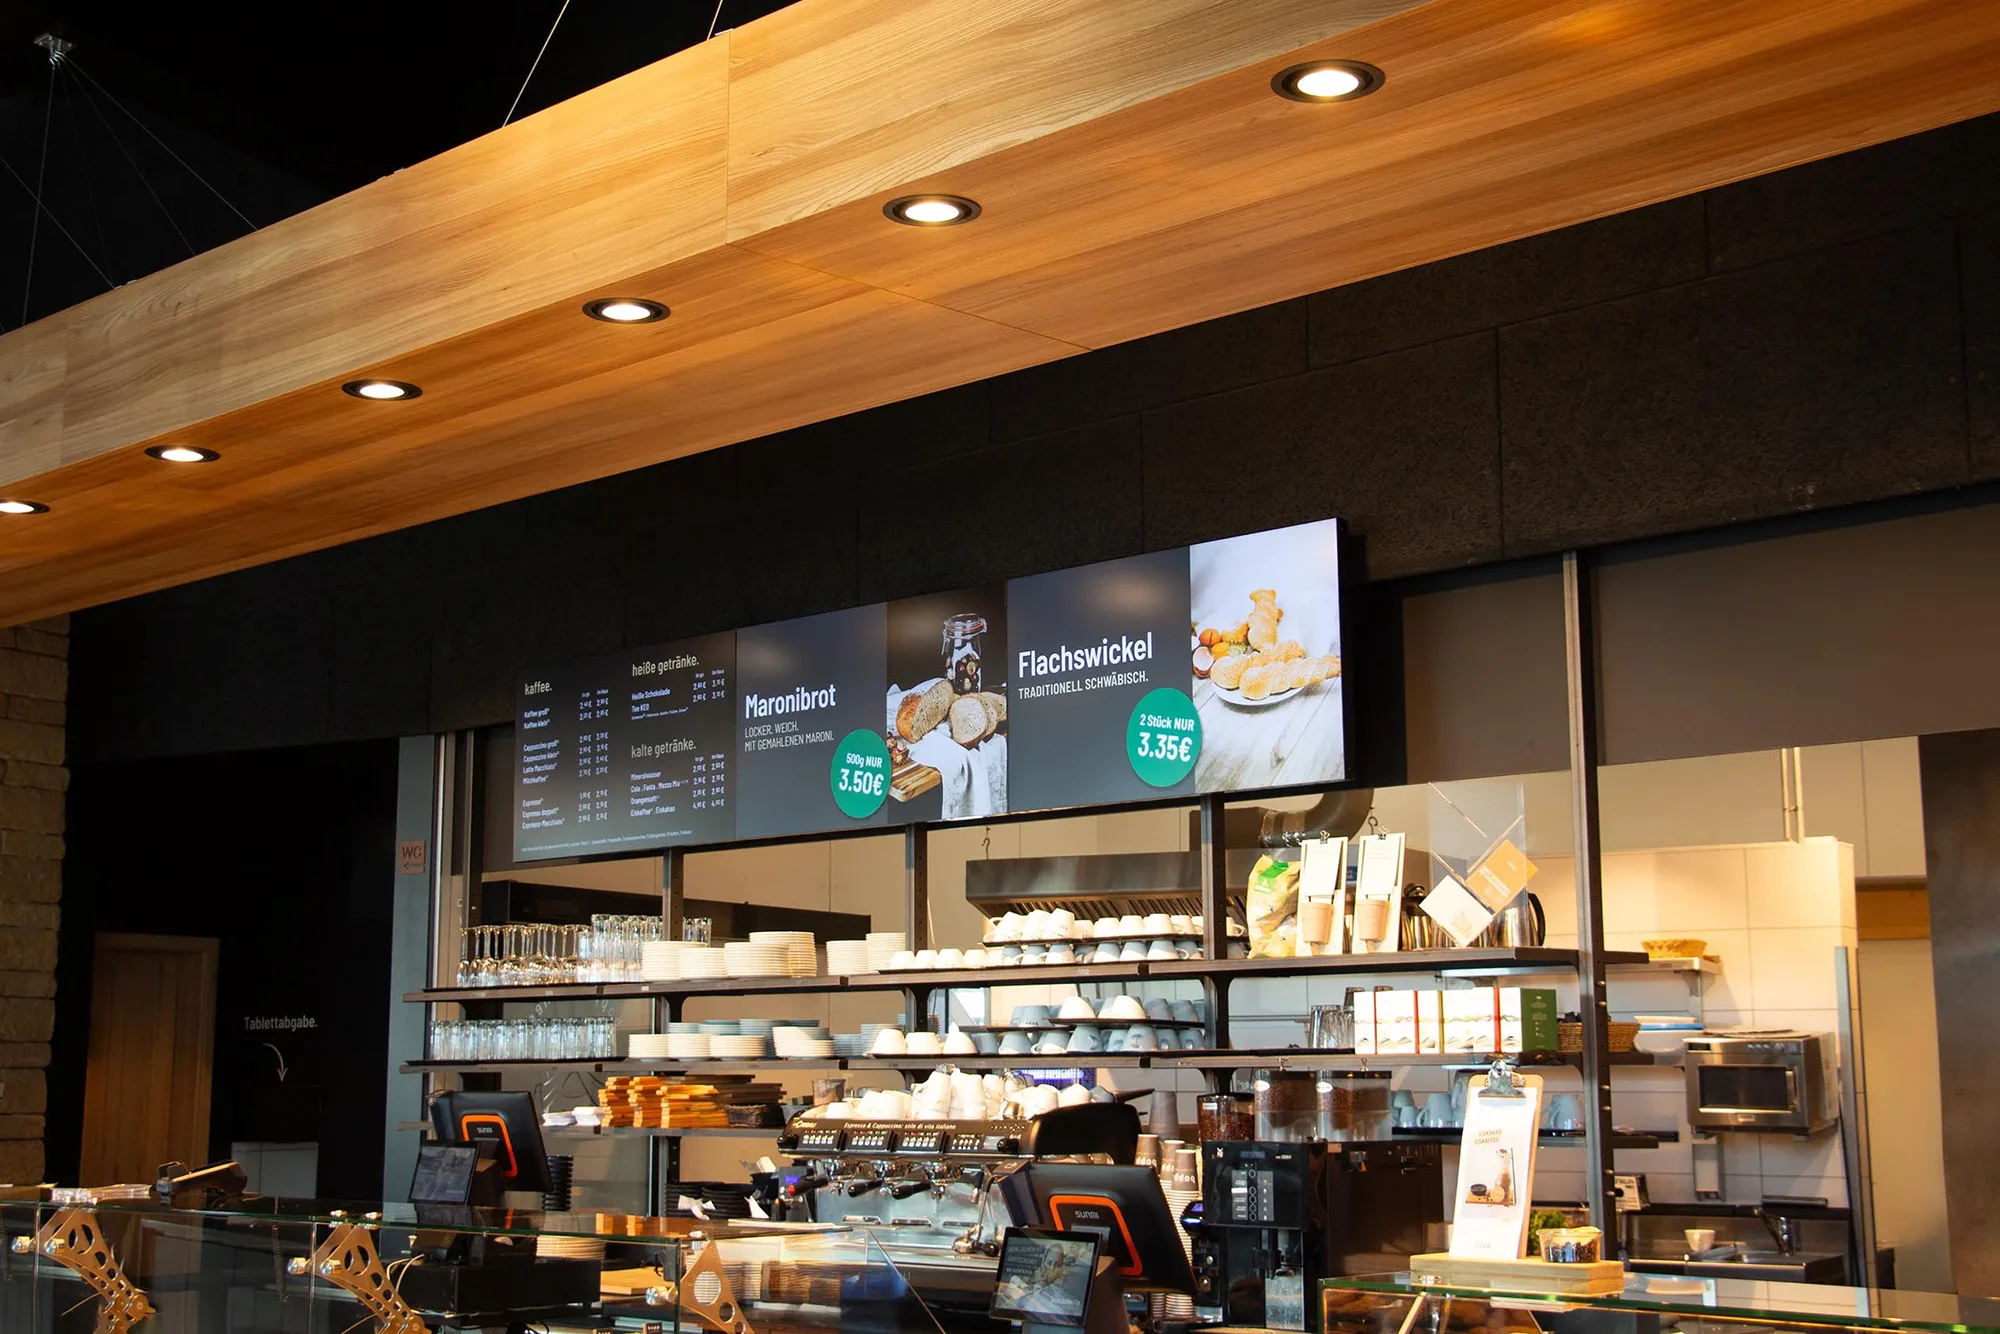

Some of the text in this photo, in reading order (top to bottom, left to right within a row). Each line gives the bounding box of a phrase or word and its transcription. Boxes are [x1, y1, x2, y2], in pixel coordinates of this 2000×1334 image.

[1018, 631, 1152, 678] Flachswickel
[632, 654, 700, 677] heiße getränke.
[525, 681, 552, 695] kaffee.
[1018, 671, 1149, 699] TRADITIONELL SCHWÄBISCH.
[745, 684, 836, 719] Maronibrot
[745, 722, 799, 738] LOCKER. WEICH.
[1140, 714, 1195, 731] 2 Stück NUR
[631, 738, 697, 759] kalte getränke.
[744, 731, 835, 752] MIT GEMAHLENEN MARONI.
[1137, 732, 1193, 762] 3.35€
[846, 752, 883, 769] 500g NUR
[839, 768, 884, 796] 3.50€
[402, 846, 422, 859] WC
[244, 1015, 318, 1032] Tablettabgabe.
